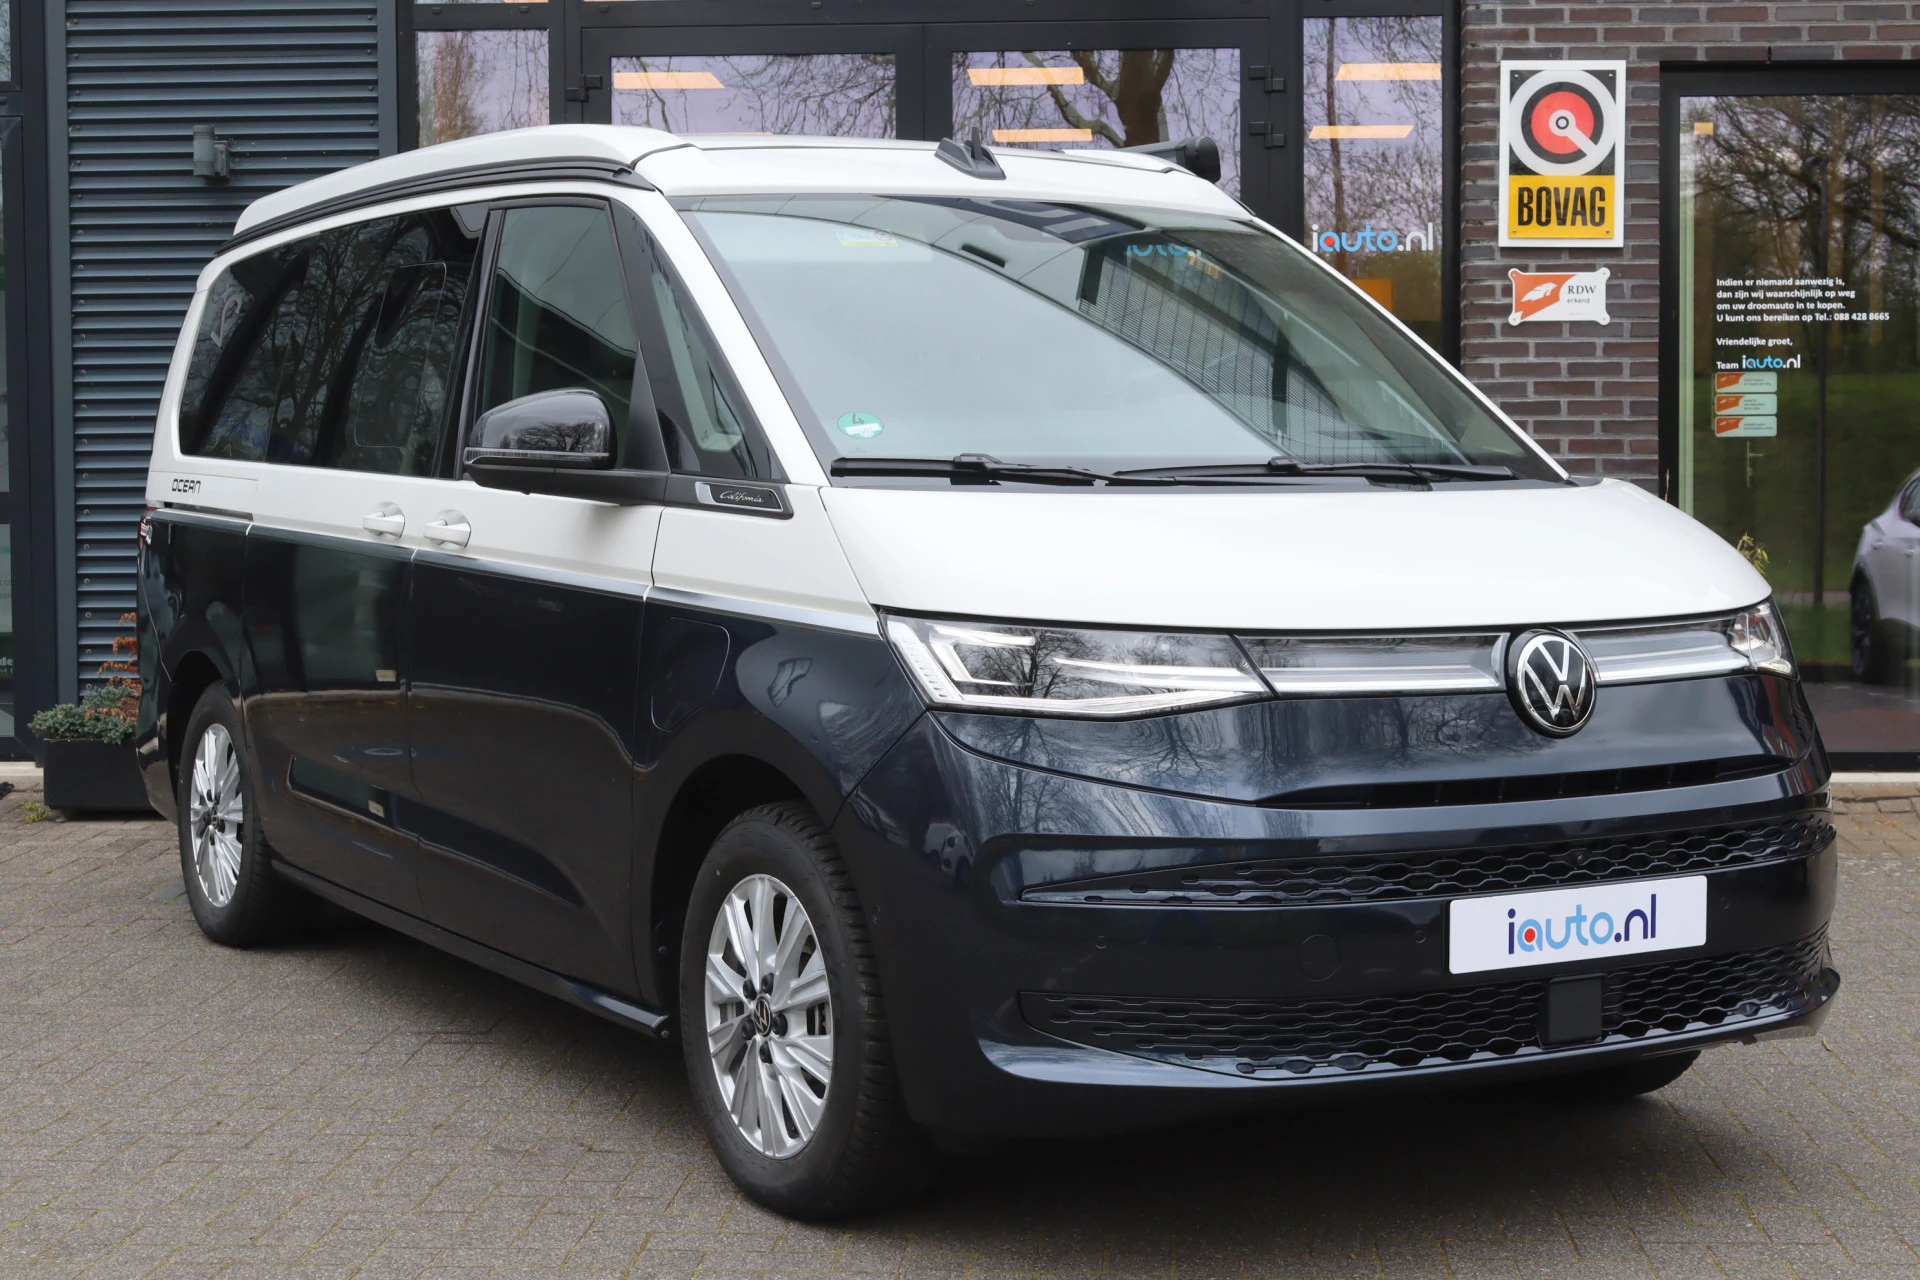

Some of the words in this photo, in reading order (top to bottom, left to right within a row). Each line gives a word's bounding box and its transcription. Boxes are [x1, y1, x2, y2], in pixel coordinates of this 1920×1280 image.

[1517, 186, 1606, 227] BOVAG
[1311, 221, 1434, 253] iauto.nl
[1716, 278, 1743, 287] Indien
[1755, 277, 1793, 286] niemand
[1794, 277, 1834, 287] aanwezig
[1835, 277, 1845, 287] is,
[1567, 284, 1597, 295] RDW
[1716, 290, 1733, 299] dan
[1734, 290, 1749, 300] zijn
[1751, 289, 1764, 300] wij
[1765, 289, 1823, 299] waarschijnlijk
[1824, 290, 1836, 299] op
[1837, 290, 1856, 299] weg
[1747, 301, 1794, 310] droomauto
[1796, 301, 1805, 309] in
[1806, 301, 1815, 309] te
[1816, 301, 1846, 311] kopen.
[1716, 314, 1724, 322] U
[1725, 313, 1745, 322] kunt
[1763, 313, 1800, 322] bereiken
[1801, 314, 1813, 323] op
[1814, 313, 1833, 321] Tel.:
[1833, 312, 1850, 321] 088
[1851, 312, 1867, 321] 428
[1868, 312, 1890, 321] 8665
[1716, 337, 1766, 347] Vriendelijke
[1767, 337, 1793, 347] groet,
[1716, 361, 1739, 370] Team
[1741, 353, 1801, 369] iauto.nl
[171, 478, 201, 494] OCEAN
[719, 490, 764, 503] California
[1507, 893, 1657, 955] iauto.nl
